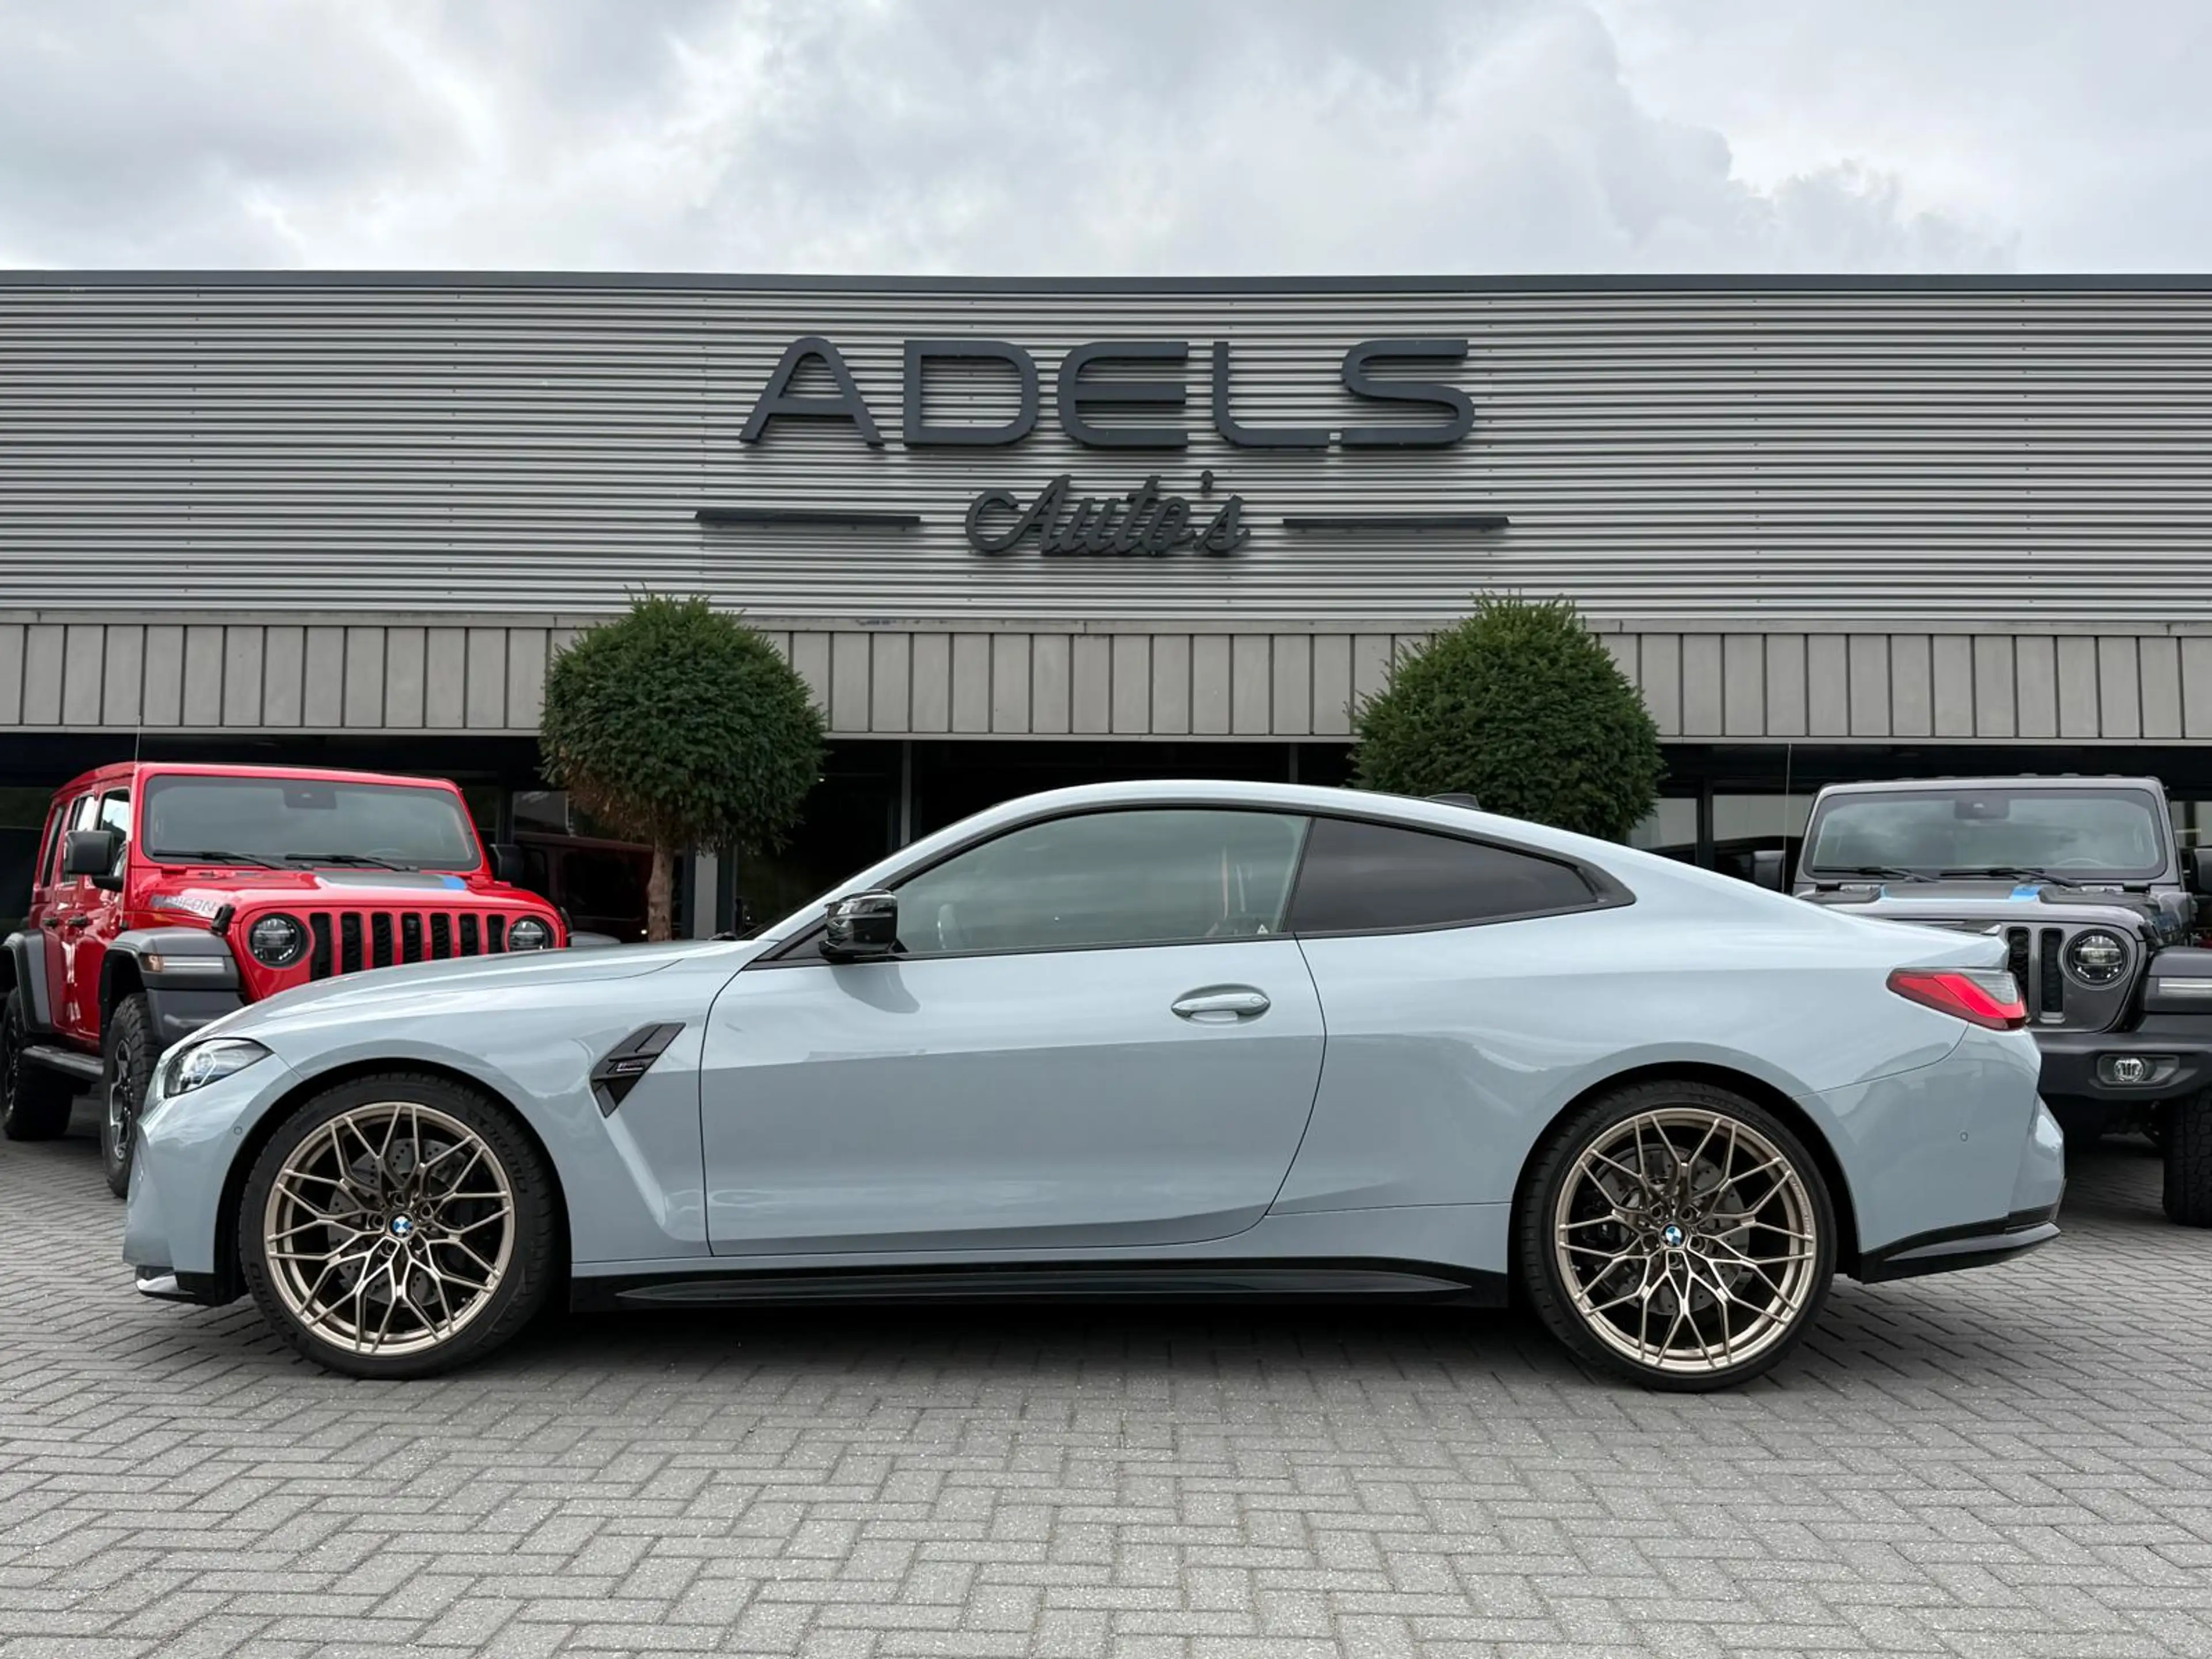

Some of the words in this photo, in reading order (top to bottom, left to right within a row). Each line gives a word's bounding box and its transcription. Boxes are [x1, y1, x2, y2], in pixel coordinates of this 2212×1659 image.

[739, 336, 1475, 449] ADELS
[965, 470, 1251, 555] Auto's
[151, 895, 216, 912] ICON
